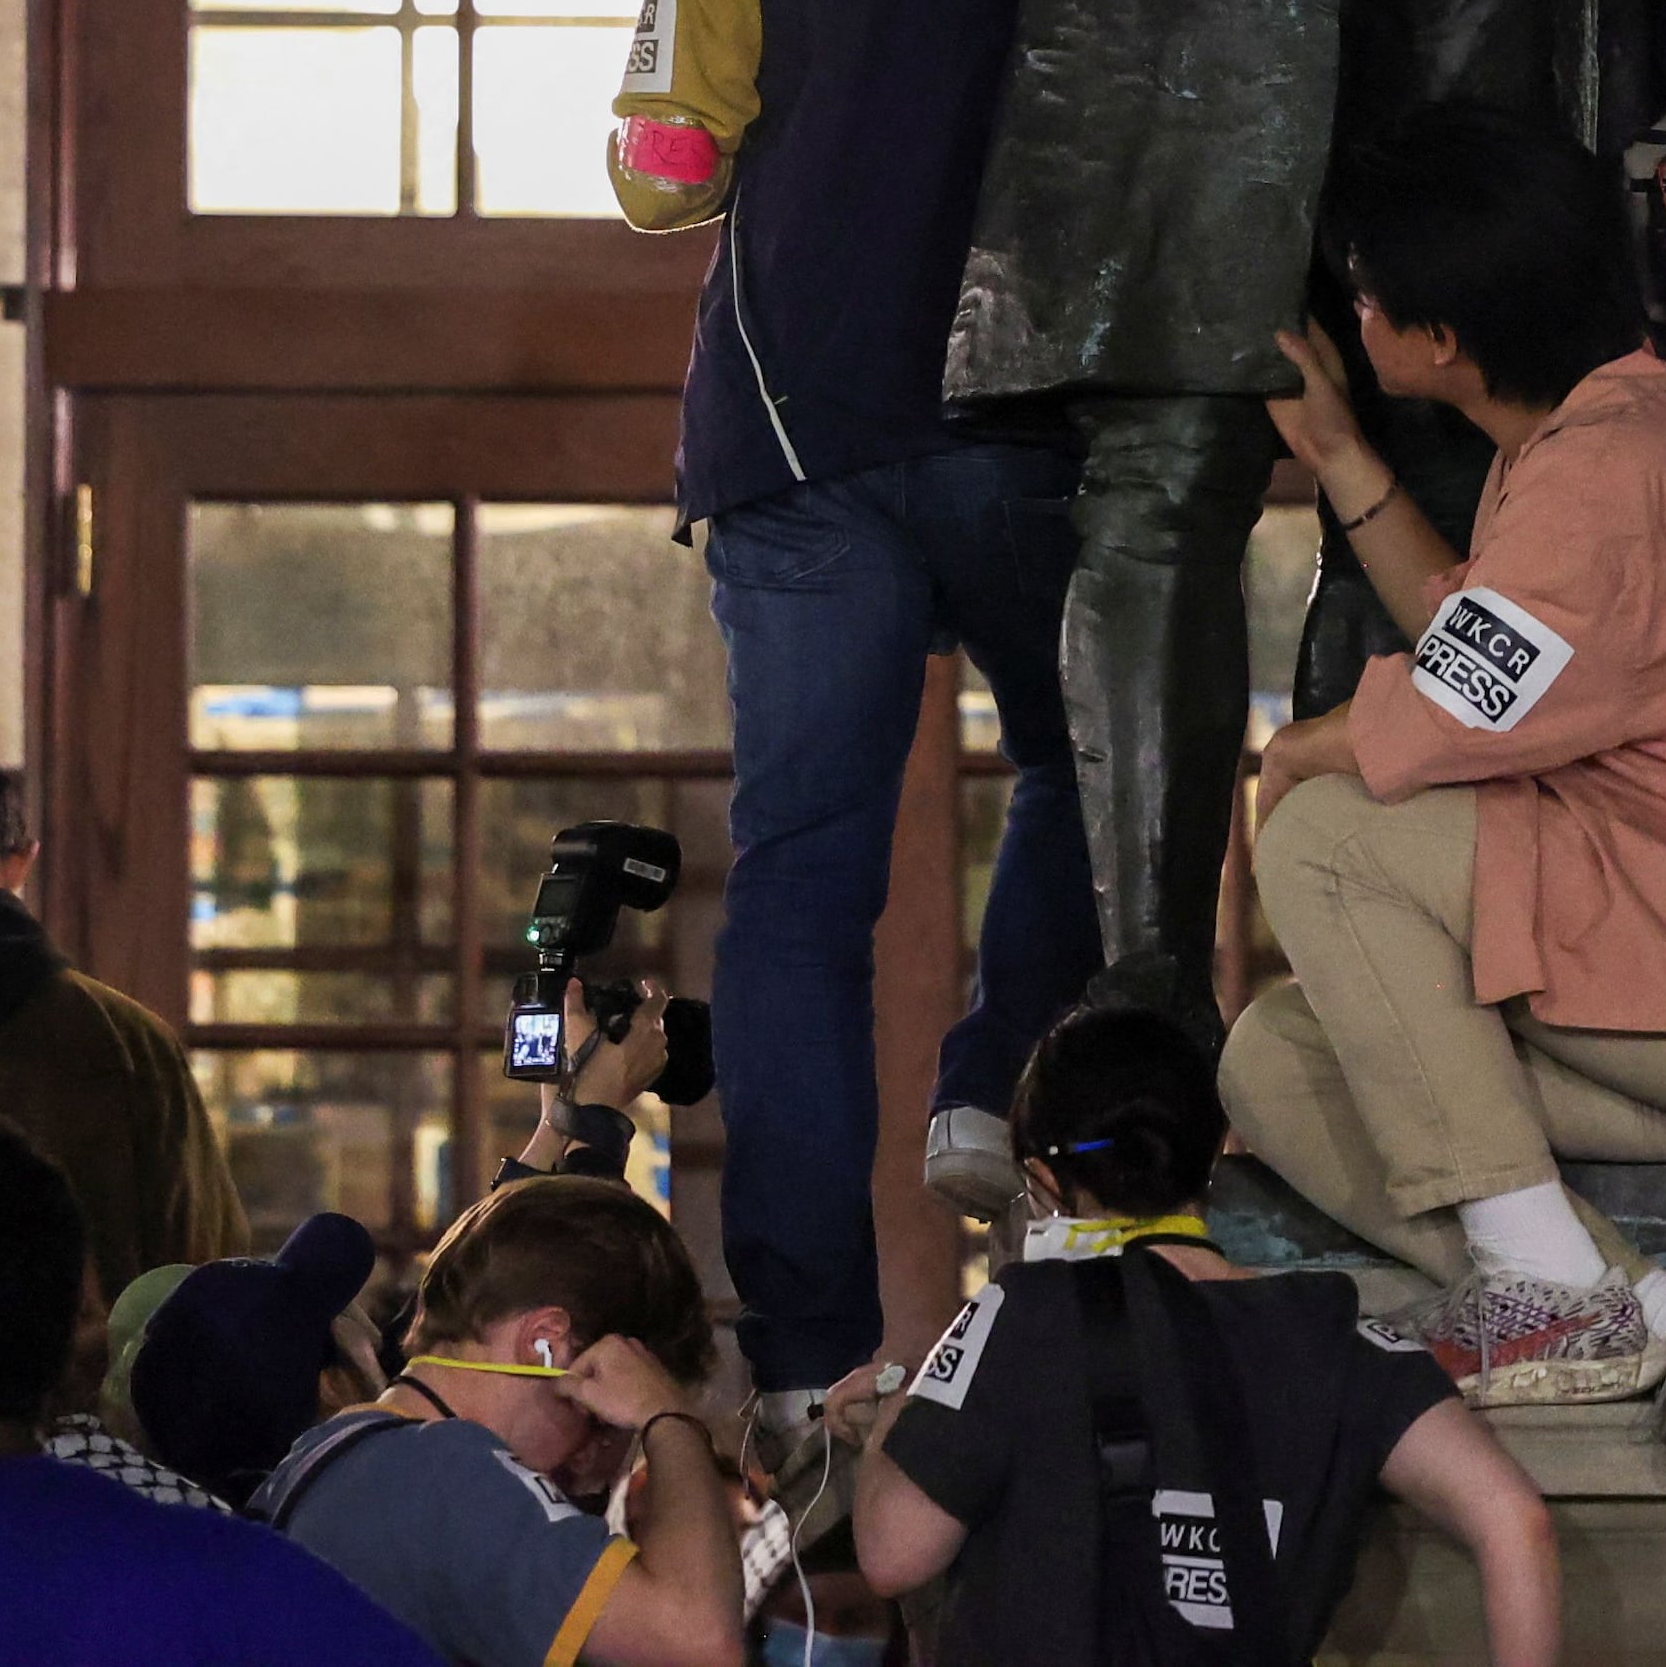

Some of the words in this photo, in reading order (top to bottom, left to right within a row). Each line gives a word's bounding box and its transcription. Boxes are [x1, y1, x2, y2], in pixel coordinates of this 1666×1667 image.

[1449, 605, 1530, 675] WKCR
[1421, 640, 1510, 717] PRESS
[1160, 1522, 1221, 1552] WKC
[1164, 1566, 1230, 1605] RES
